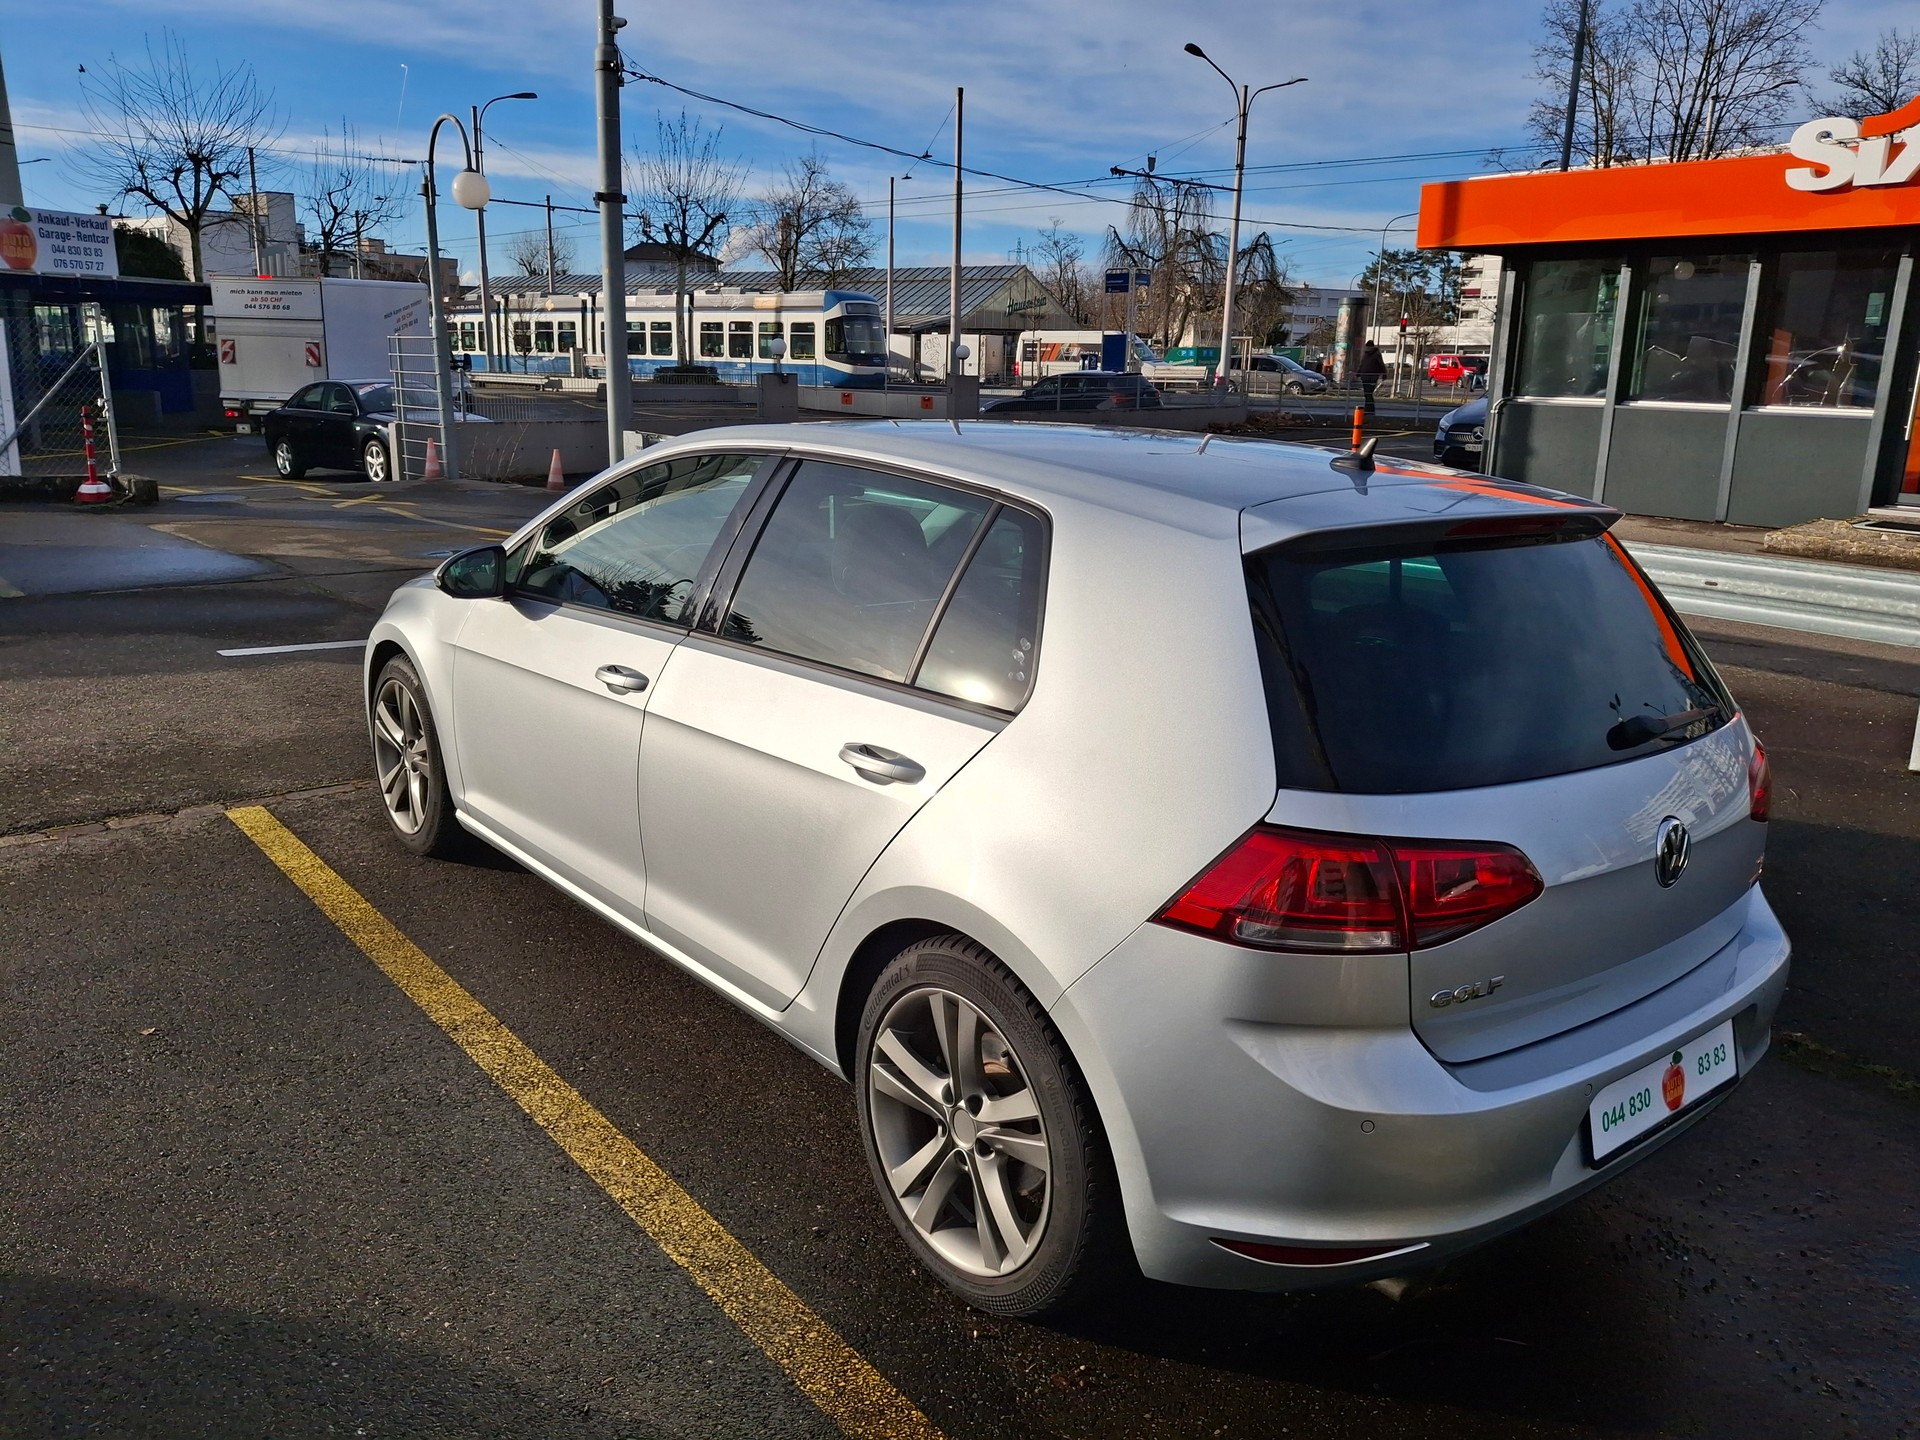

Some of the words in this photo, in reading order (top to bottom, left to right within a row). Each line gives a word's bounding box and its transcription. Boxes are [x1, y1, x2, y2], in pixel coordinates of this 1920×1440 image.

[51, 244, 65, 254] 044
[68, 246, 81, 256] 830
[83, 247, 92, 257] 83
[94, 248, 103, 258] 83
[53, 258, 68, 268] 076
[69, 260, 83, 270] 570
[85, 261, 94, 271] 57
[96, 262, 104, 271] 27
[864, 966, 903, 1031] Continental
[1430, 975, 1505, 1008] GOLF
[1697, 1052, 1711, 1076] 83
[1713, 1043, 1726, 1066] 83
[1602, 1101, 1625, 1133] 044
[1629, 1087, 1651, 1117] 830
